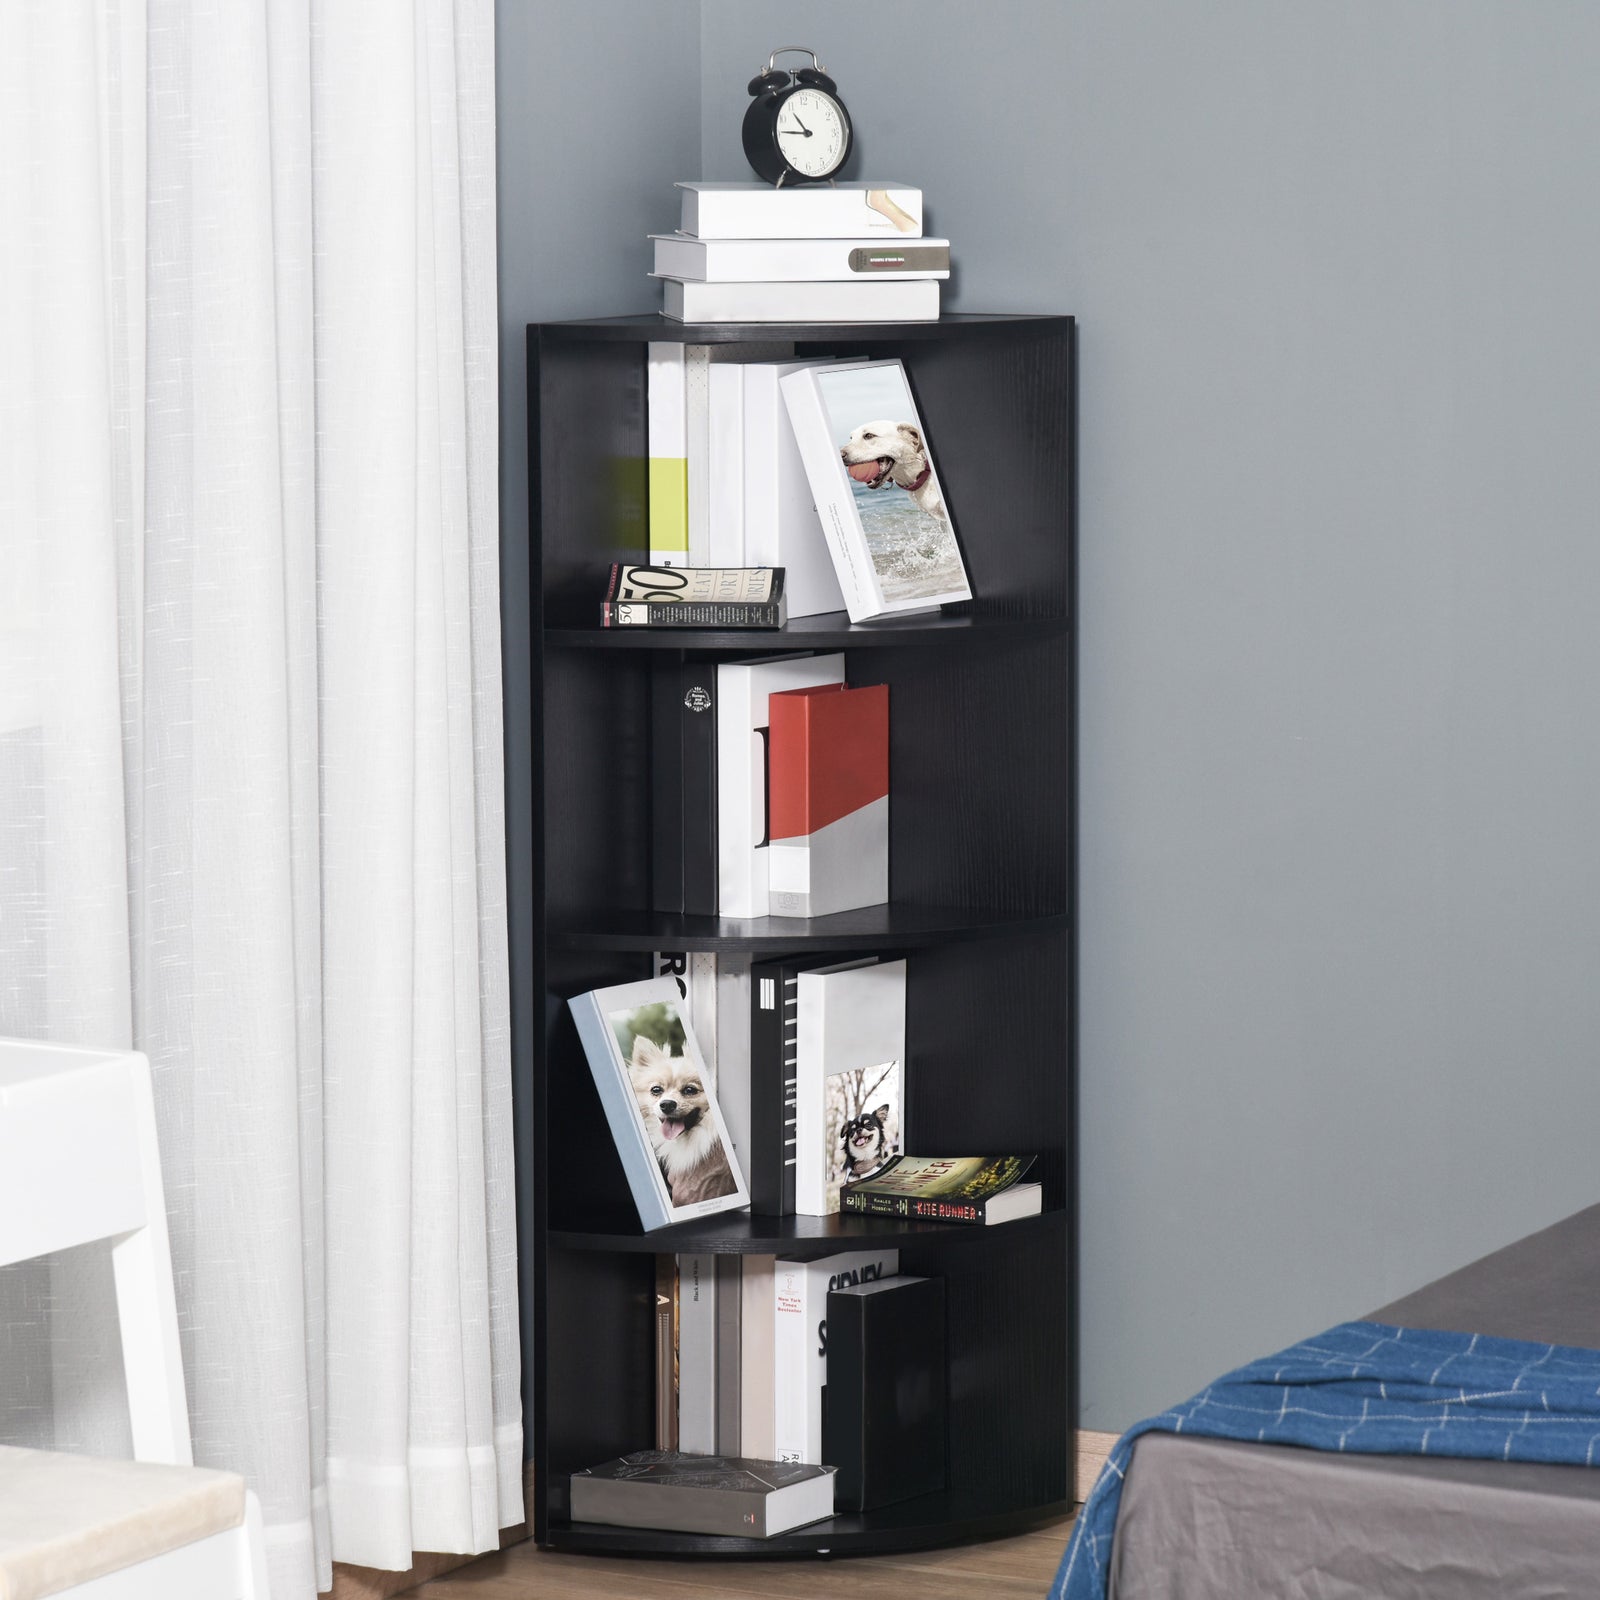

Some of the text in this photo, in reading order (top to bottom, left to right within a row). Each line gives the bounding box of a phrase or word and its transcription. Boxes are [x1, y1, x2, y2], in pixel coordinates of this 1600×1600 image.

[800, 96, 808, 106] 12
[825, 112, 831, 121] 2
[690, 570, 712, 601] REAT
[619, 604, 632, 624] 50
[917, 1201, 937, 1217] KITE
[938, 1202, 977, 1220] RUNNER
